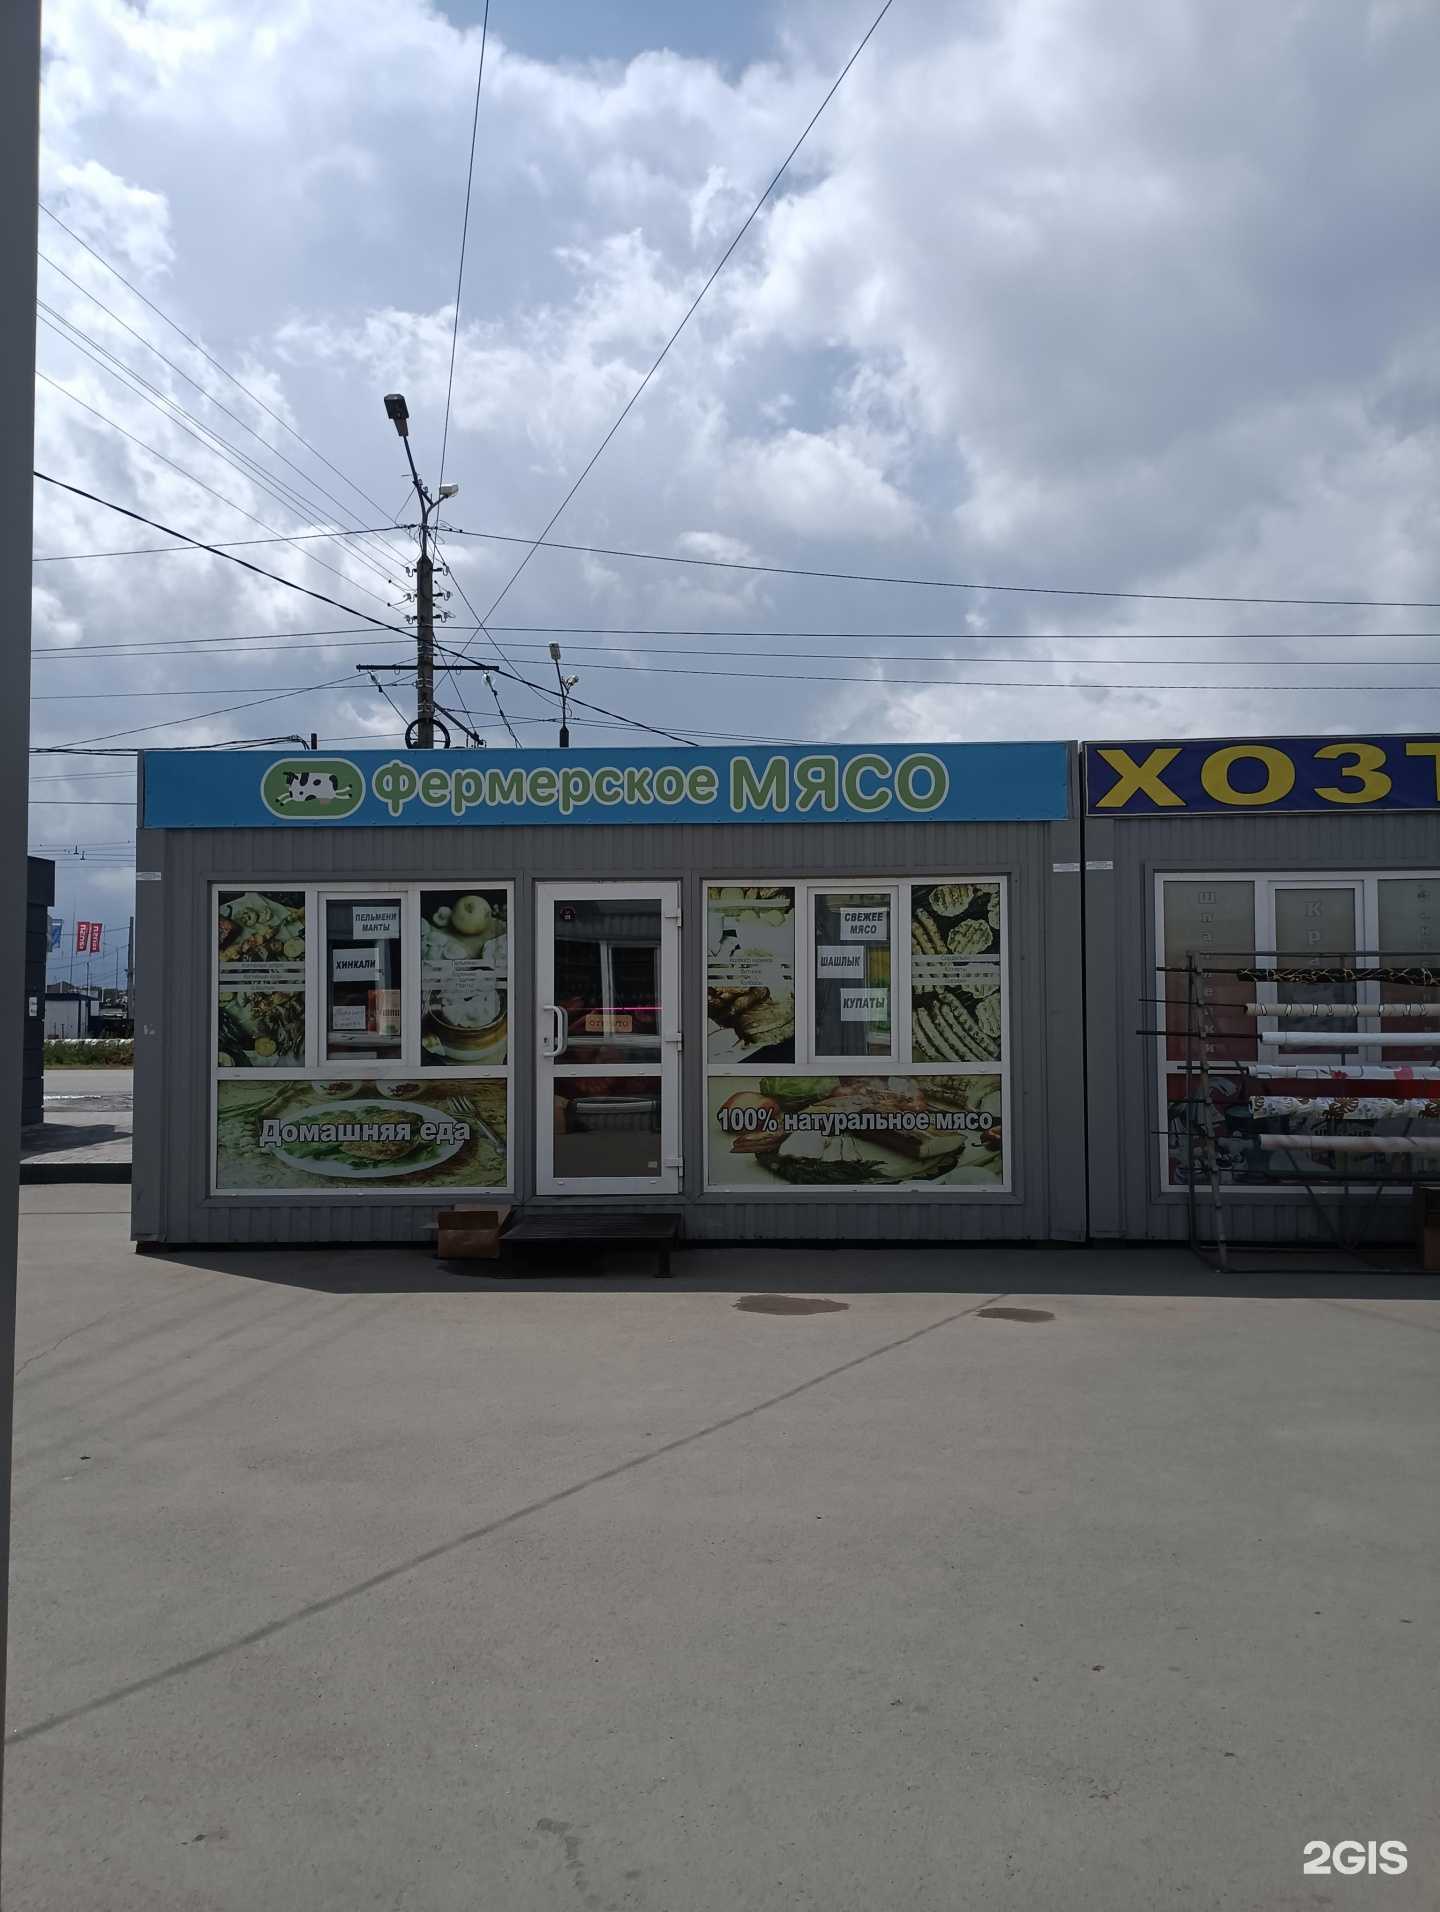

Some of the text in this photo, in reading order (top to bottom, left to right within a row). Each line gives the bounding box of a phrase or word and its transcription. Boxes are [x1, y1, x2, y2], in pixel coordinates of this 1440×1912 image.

[372, 754, 949, 817] Фермерское МЯСО
[355, 912, 397, 921] ПЕЛЬМЕНИ
[844, 912, 884, 922] СВЕЖЕЕ
[362, 923, 390, 932] МАНТЫ
[850, 925, 877, 935] МЯСО
[335, 959, 376, 969] ХИНКАЛИ
[820, 956, 861, 967] ШАШЛЫК
[843, 998, 885, 1009] КУПАТЫ
[718, 1106, 994, 1137] 100% натуральное мясо
[259, 1118, 472, 1148] Домашняя еда
